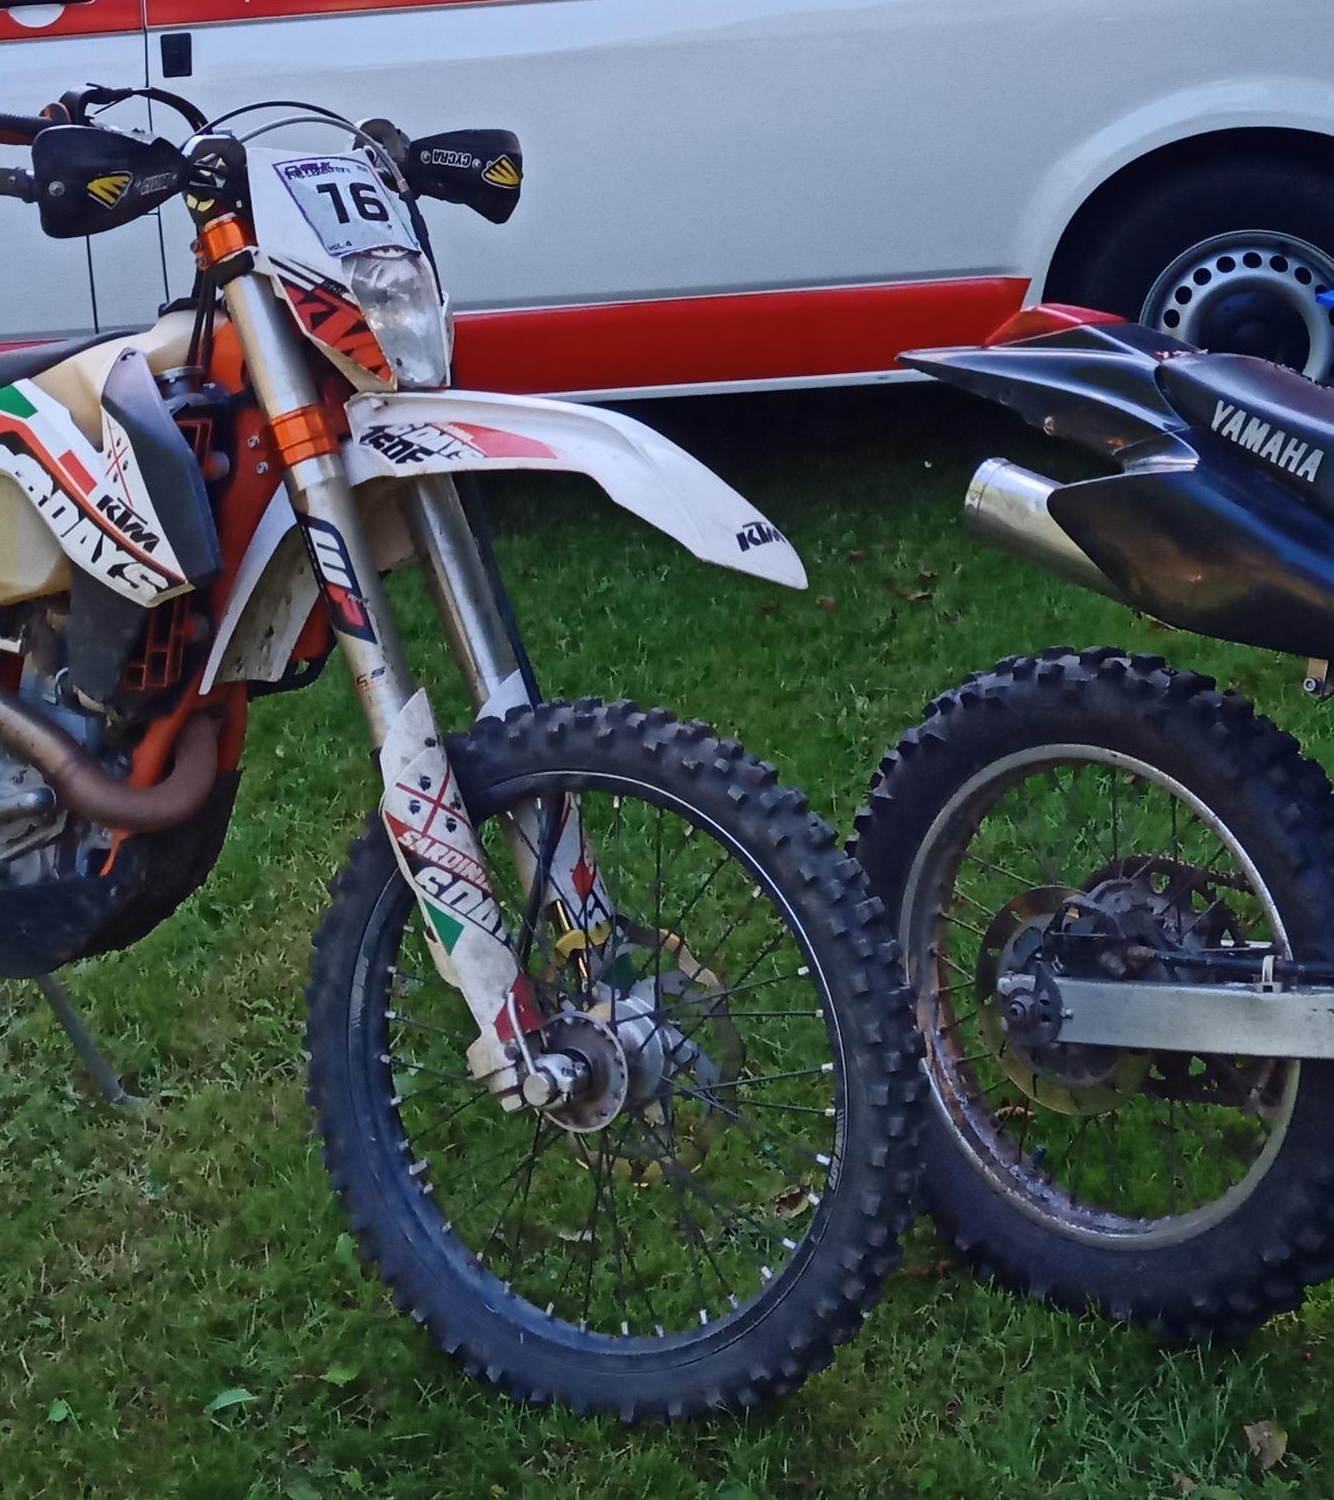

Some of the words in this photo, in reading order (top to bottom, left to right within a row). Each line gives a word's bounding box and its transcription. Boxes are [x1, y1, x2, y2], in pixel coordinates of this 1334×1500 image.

[432, 149, 472, 168] CYCRA
[316, 182, 390, 224] 16
[1211, 400, 1325, 483] YAMAHA
[95, 494, 161, 554] KTM
[735, 521, 787, 553] KTM
